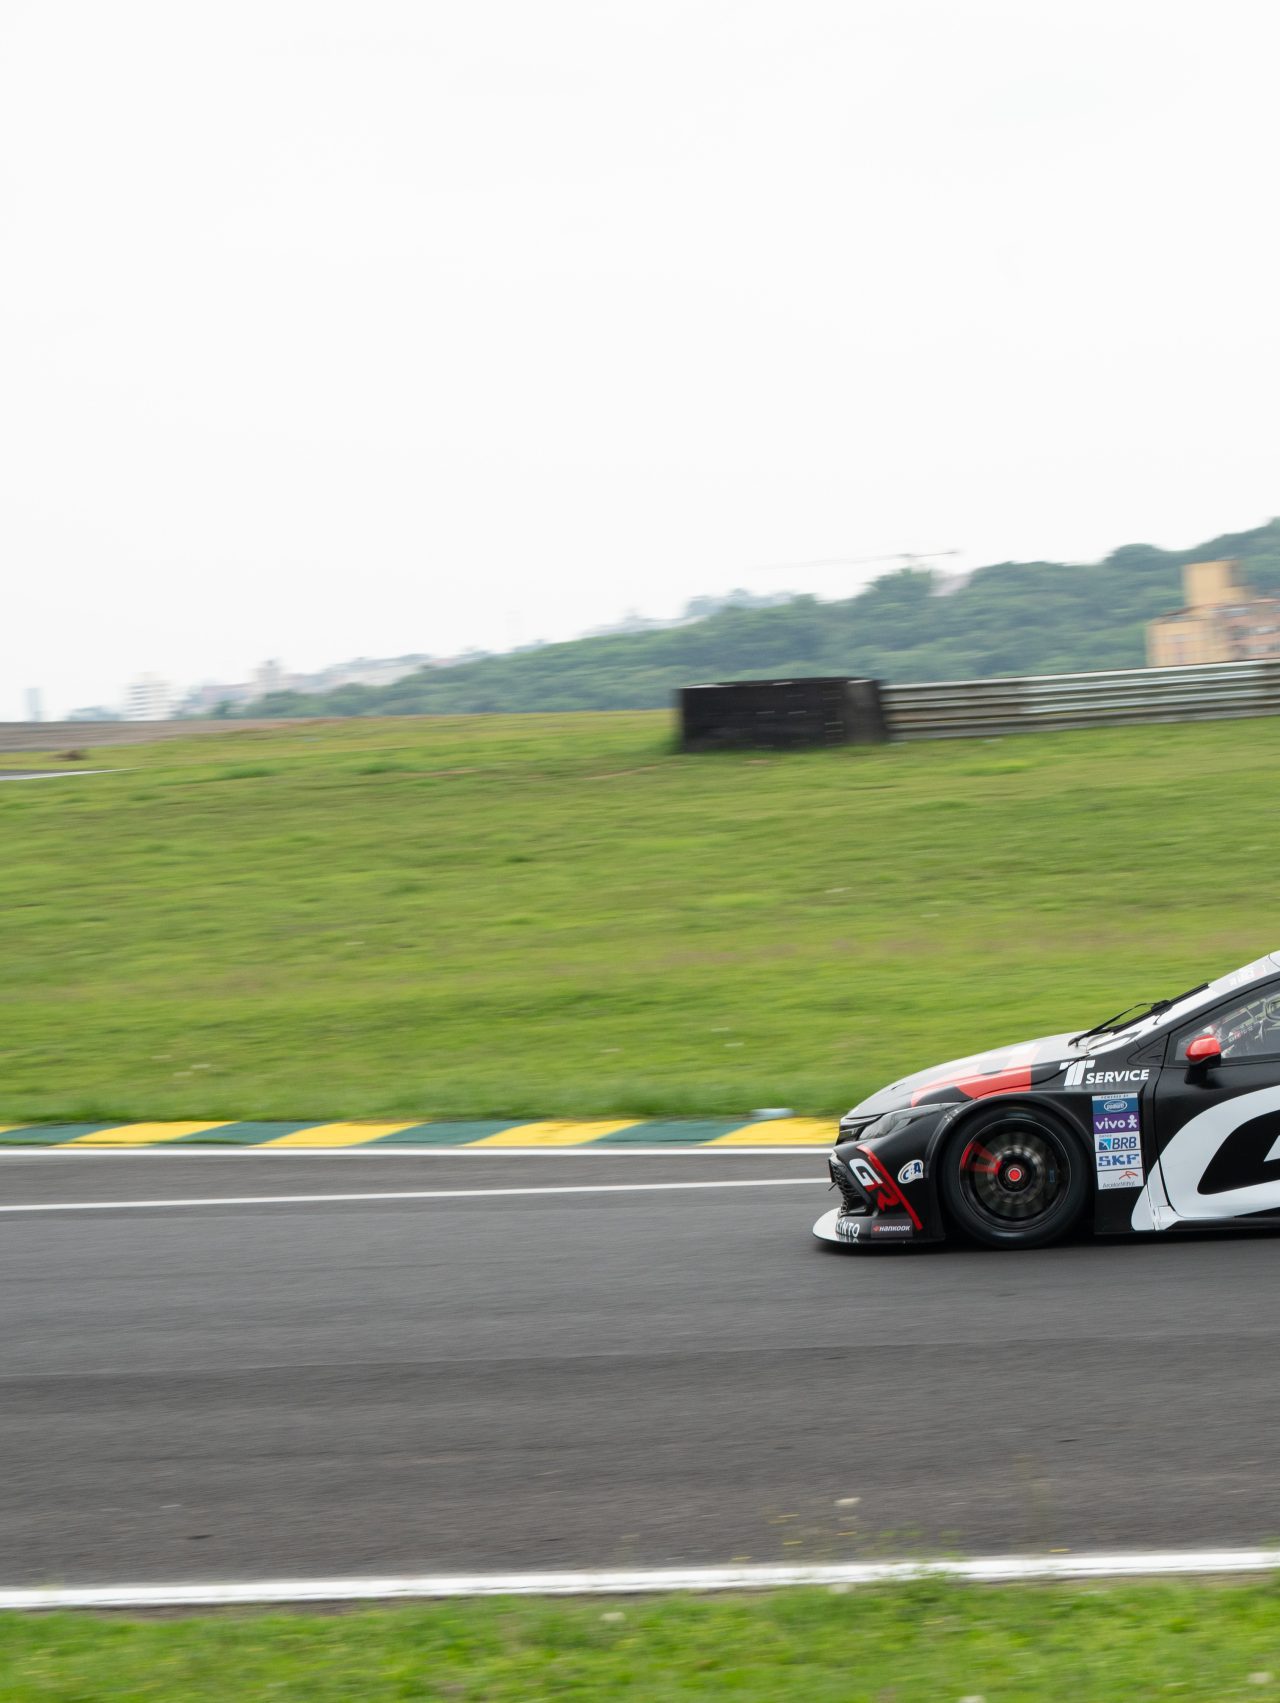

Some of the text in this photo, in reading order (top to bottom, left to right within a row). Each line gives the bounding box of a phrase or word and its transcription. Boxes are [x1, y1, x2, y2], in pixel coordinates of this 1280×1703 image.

[1086, 1069, 1150, 1085] SERVICE
[1095, 1117, 1126, 1130] vivo
[1112, 1136, 1137, 1150] BRB
[1098, 1153, 1140, 1167] SKF
